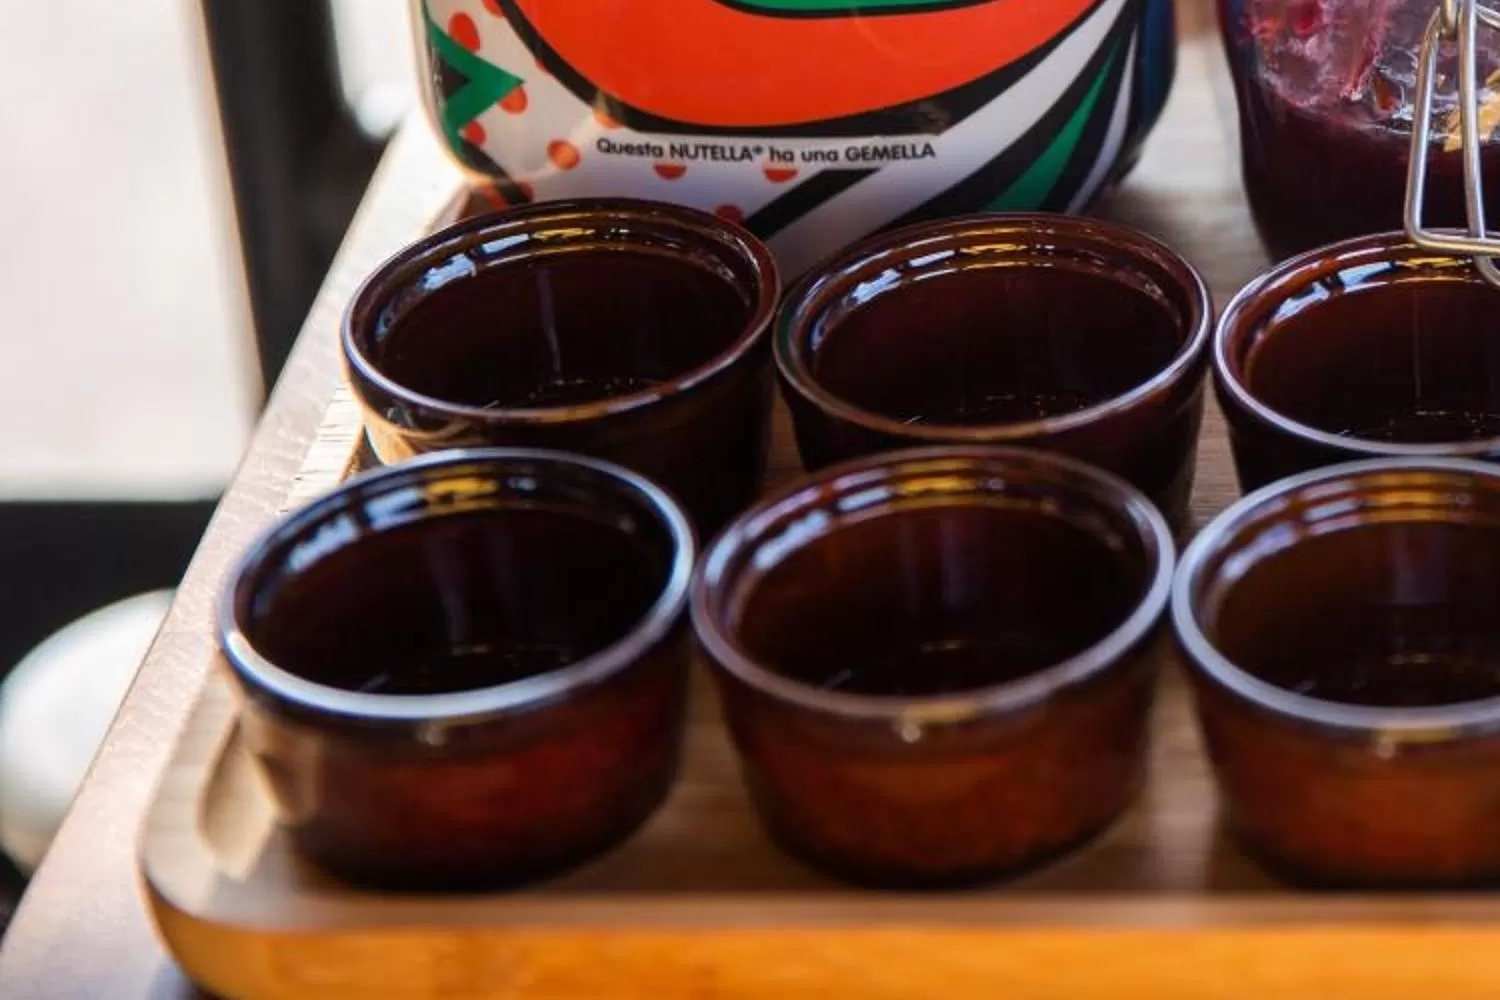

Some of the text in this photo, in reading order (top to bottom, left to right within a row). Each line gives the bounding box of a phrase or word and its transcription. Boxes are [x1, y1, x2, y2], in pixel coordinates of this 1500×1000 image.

[596, 137, 664, 158] Questa
[768, 145, 795, 162] ha
[801, 147, 839, 163] una
[844, 141, 936, 161] GEMELLA
